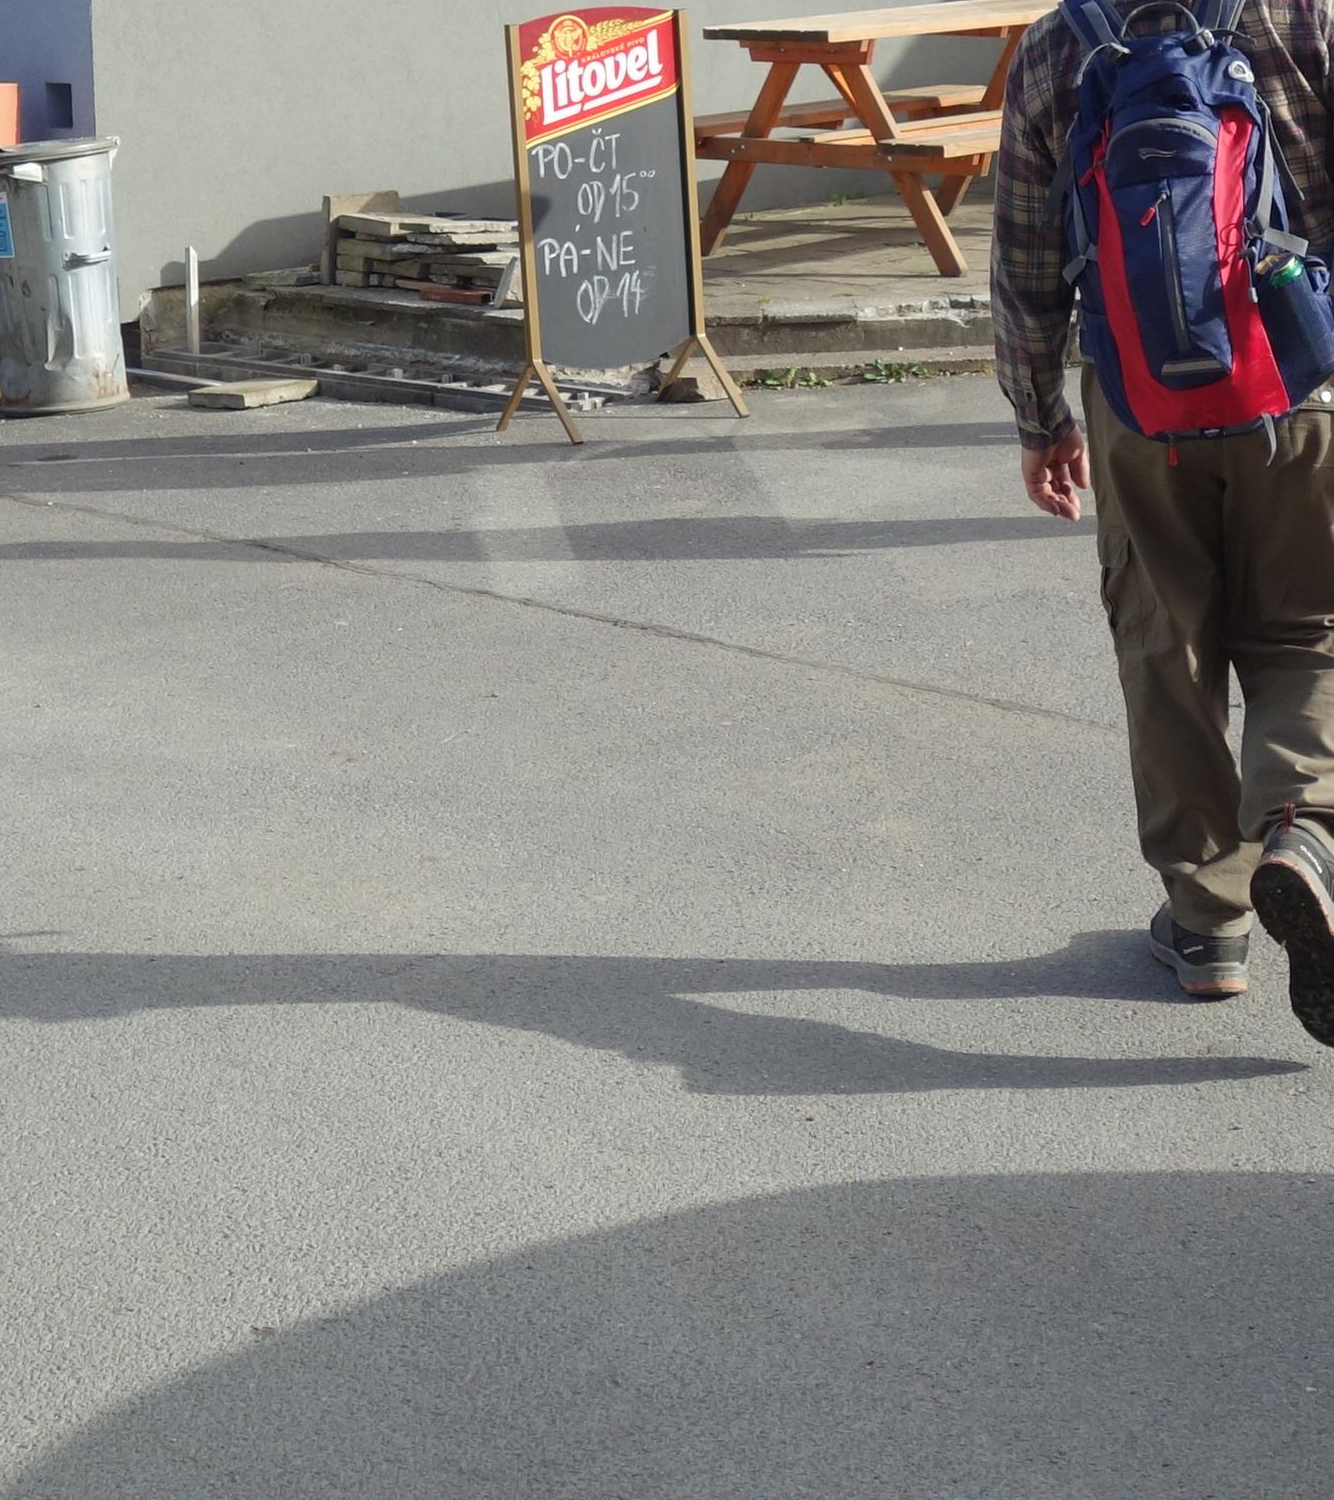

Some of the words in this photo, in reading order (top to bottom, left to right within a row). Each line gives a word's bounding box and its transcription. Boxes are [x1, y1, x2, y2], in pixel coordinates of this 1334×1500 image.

[540, 28, 664, 126] Litovel
[531, 128, 621, 180] PO-ČT
[577, 180, 605, 224] OD
[537, 224, 636, 278] PÁ-NE
[576, 275, 609, 326] OD
